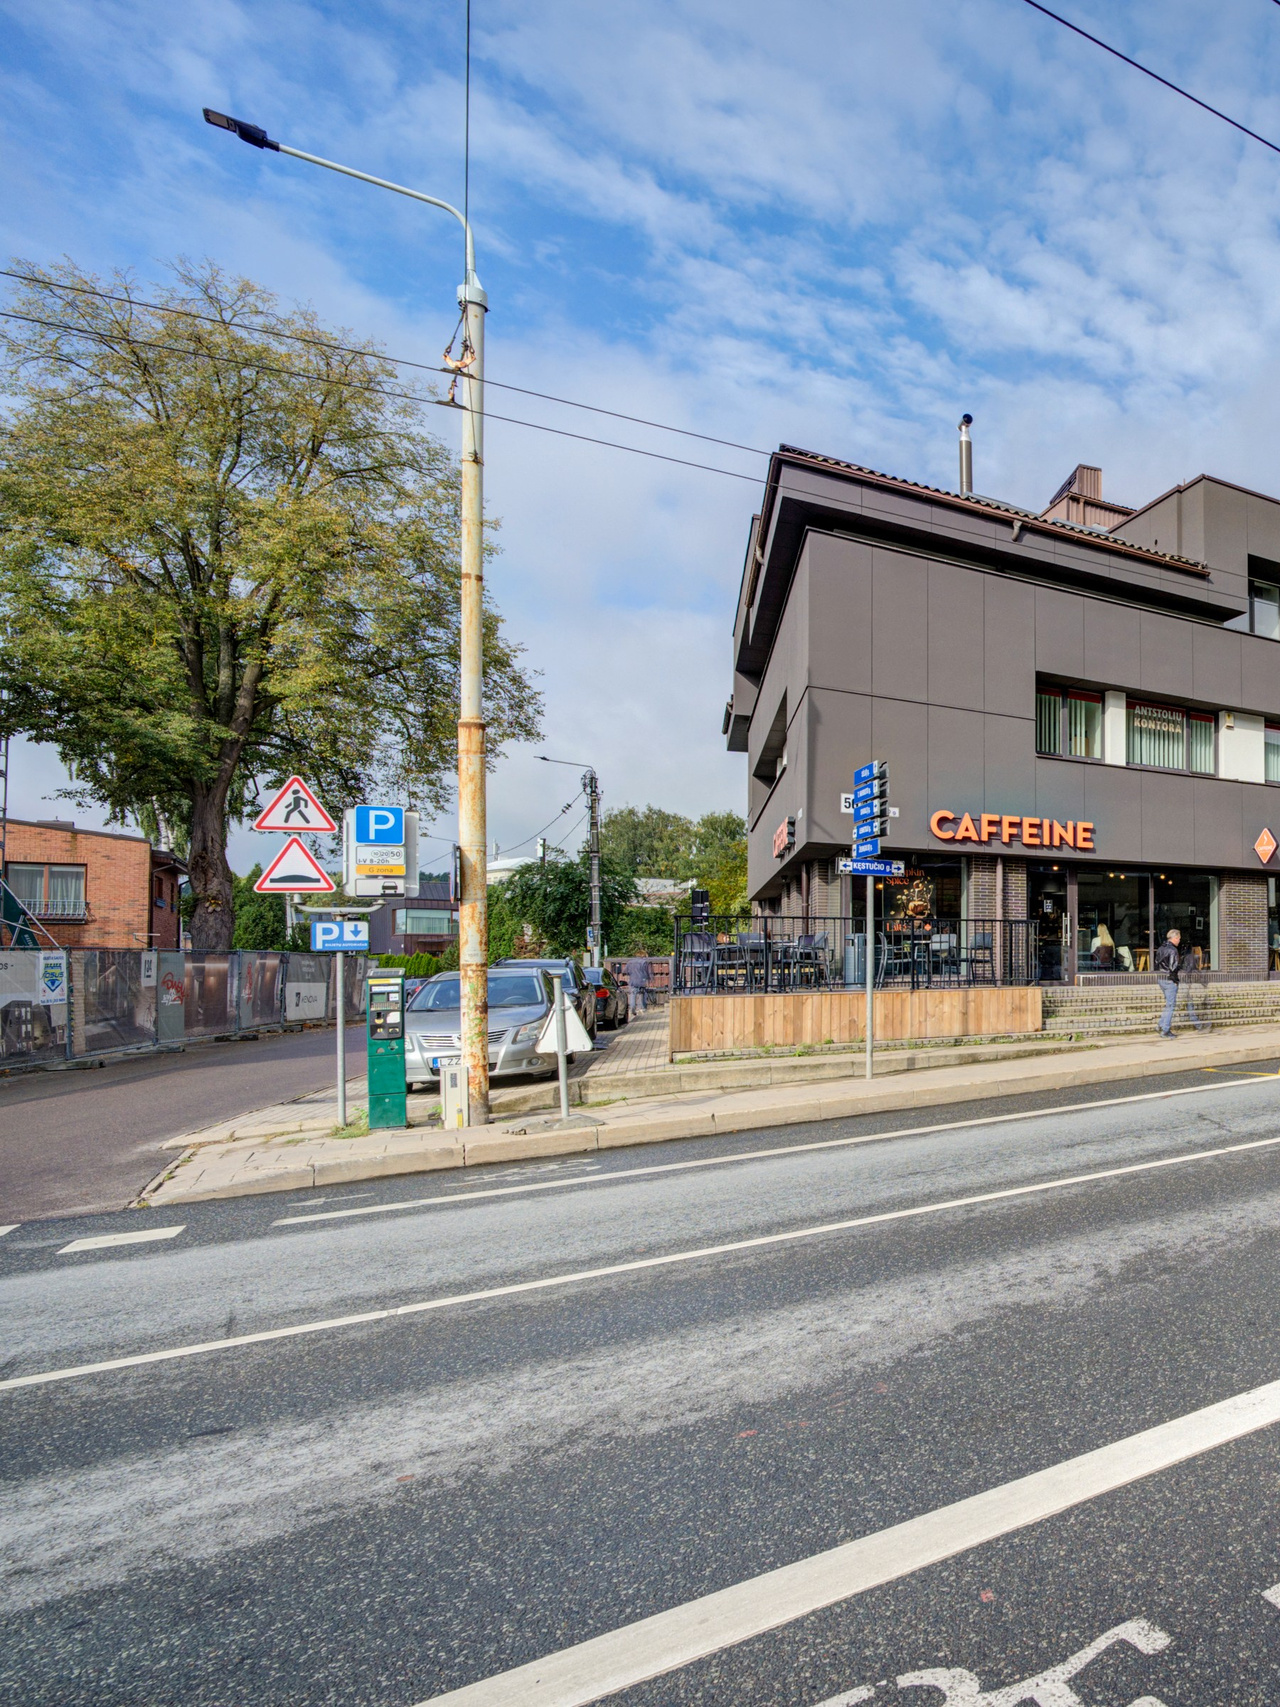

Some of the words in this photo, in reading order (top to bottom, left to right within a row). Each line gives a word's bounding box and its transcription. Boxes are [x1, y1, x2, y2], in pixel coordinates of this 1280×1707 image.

[1134, 718, 1182, 733] KONTORA
[1135, 705, 1183, 724] ANTSTOLIŲ
[369, 810, 395, 840] P
[930, 809, 1094, 849] CAFFEINE
[853, 861, 885, 873] KĘSTUČIO
[886, 865, 892, 874] g.
[316, 924, 339, 949] P
